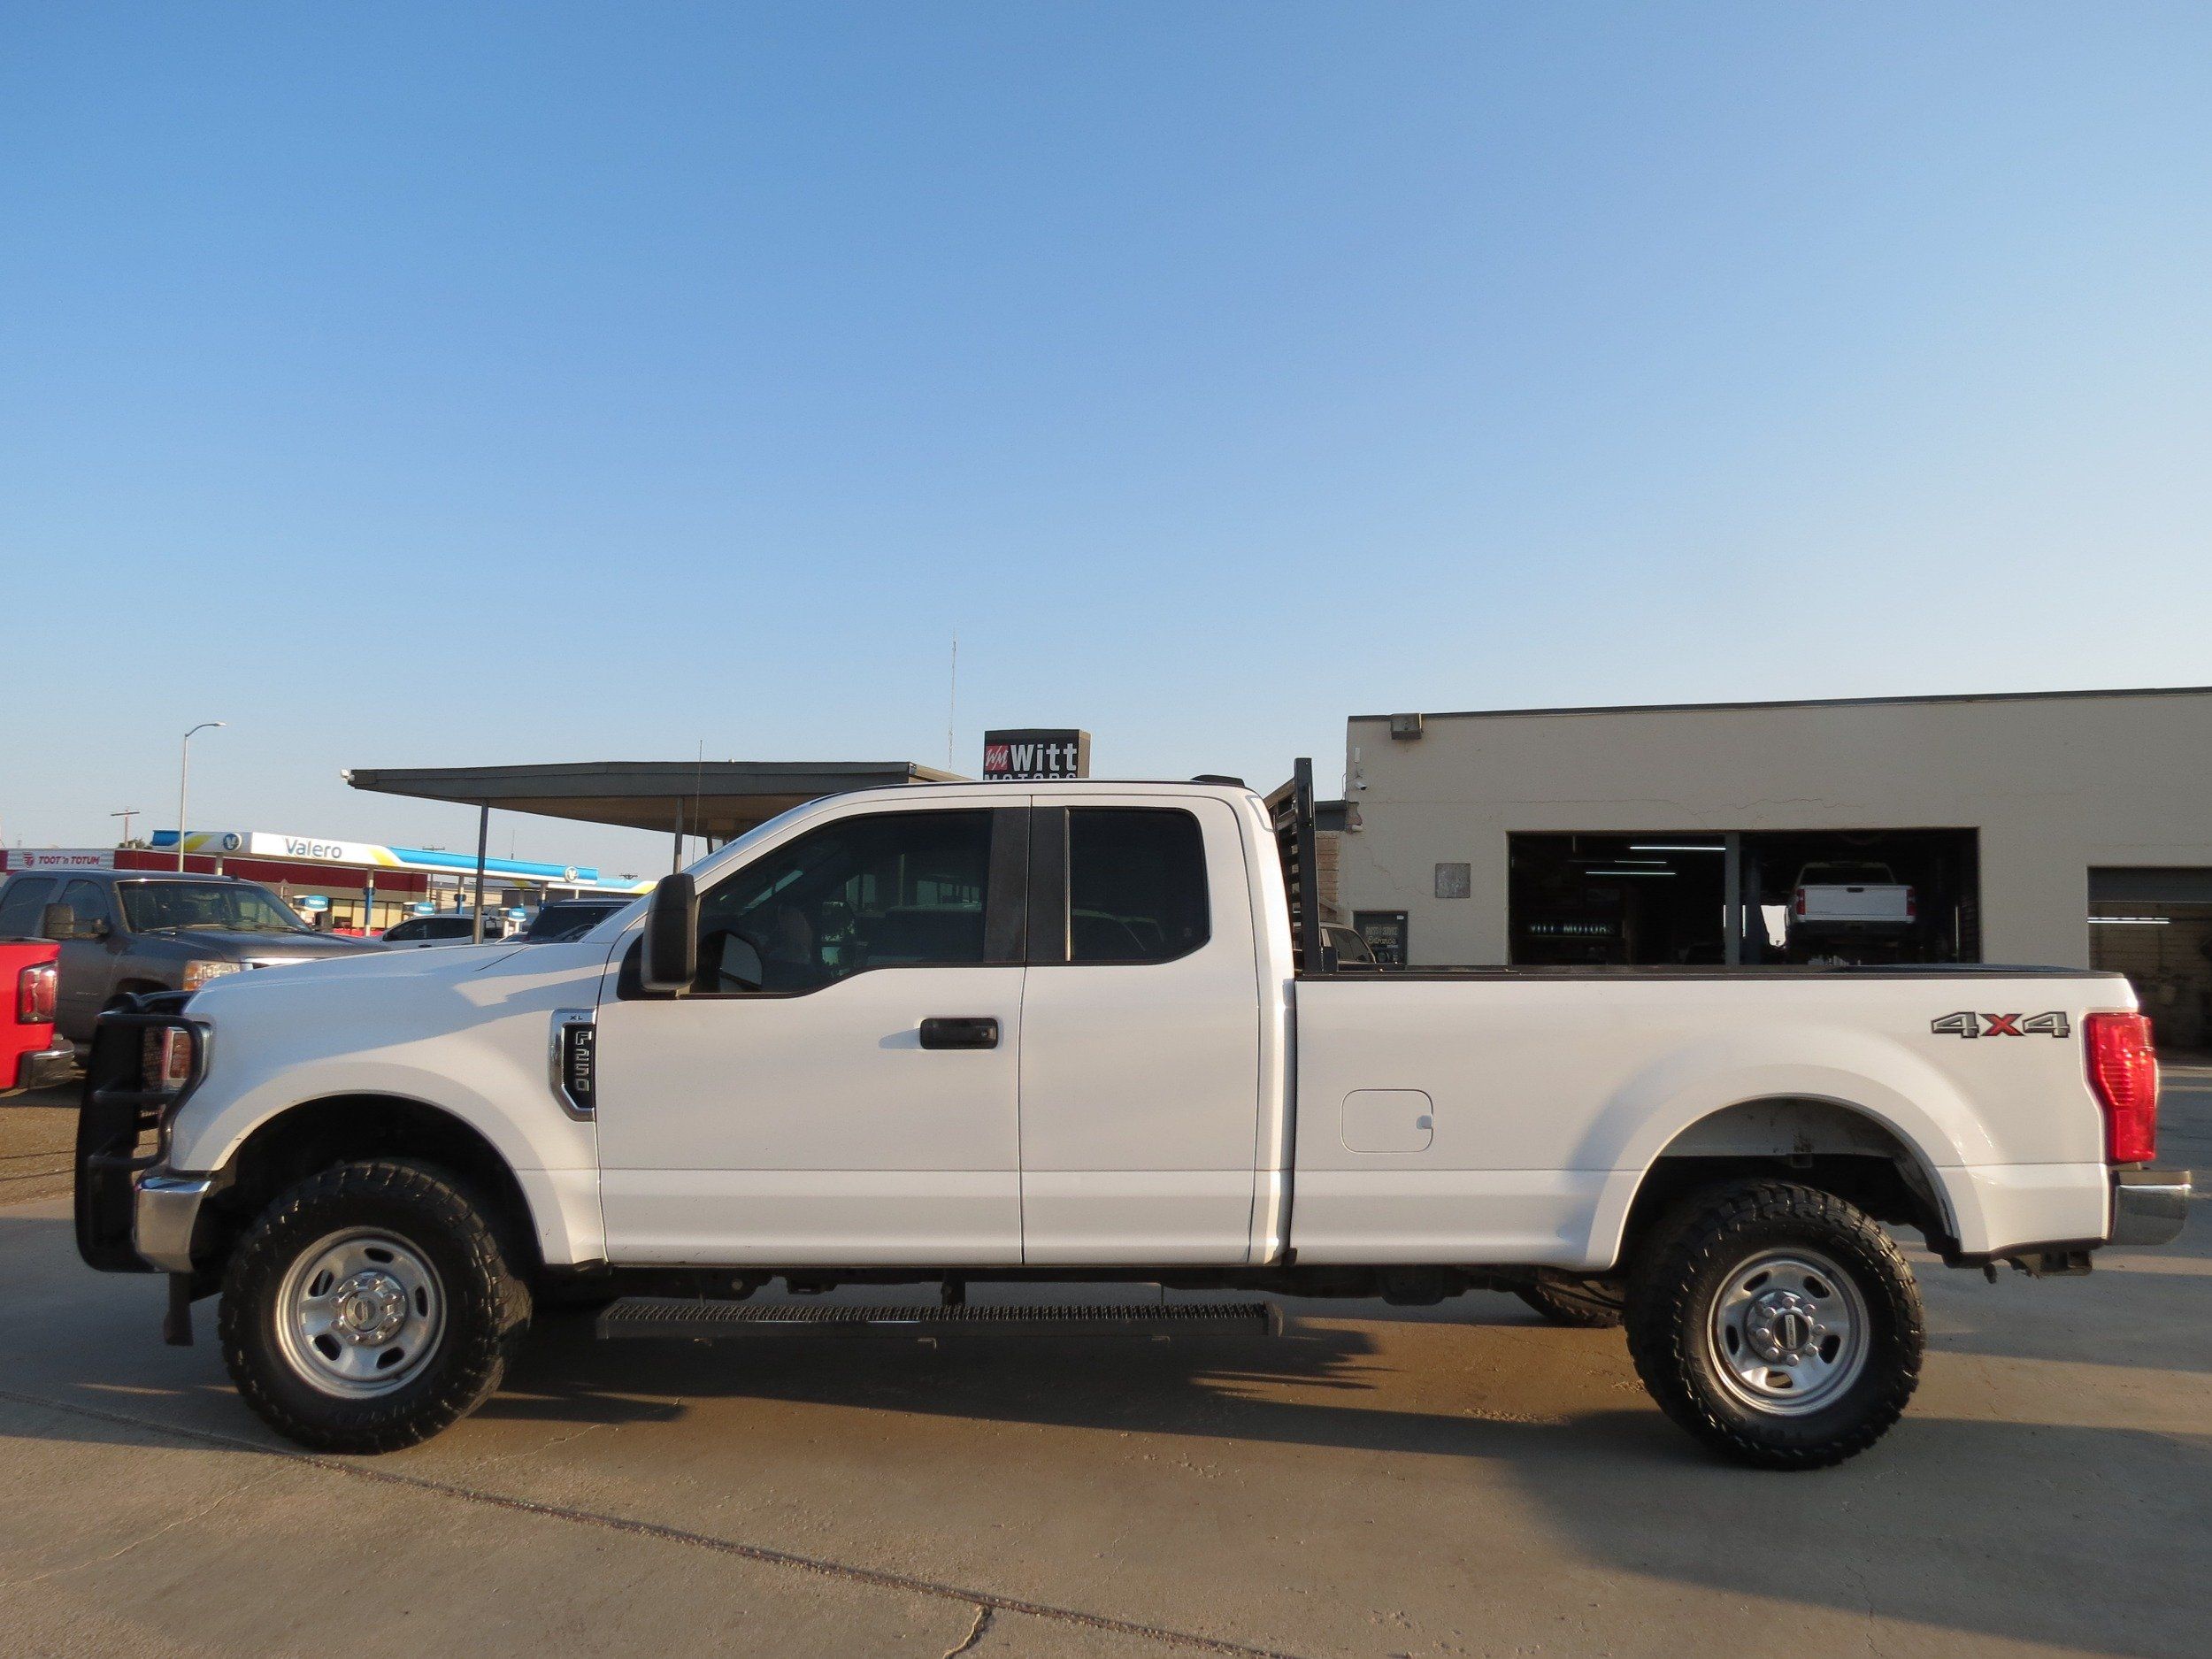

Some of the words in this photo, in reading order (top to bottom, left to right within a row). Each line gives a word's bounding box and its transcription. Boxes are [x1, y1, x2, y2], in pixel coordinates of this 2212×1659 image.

[1010, 743, 1078, 772] Witt
[284, 837, 342, 859] Valero
[38, 856, 61, 864] TOOT
[70, 856, 101, 865] TOTUM
